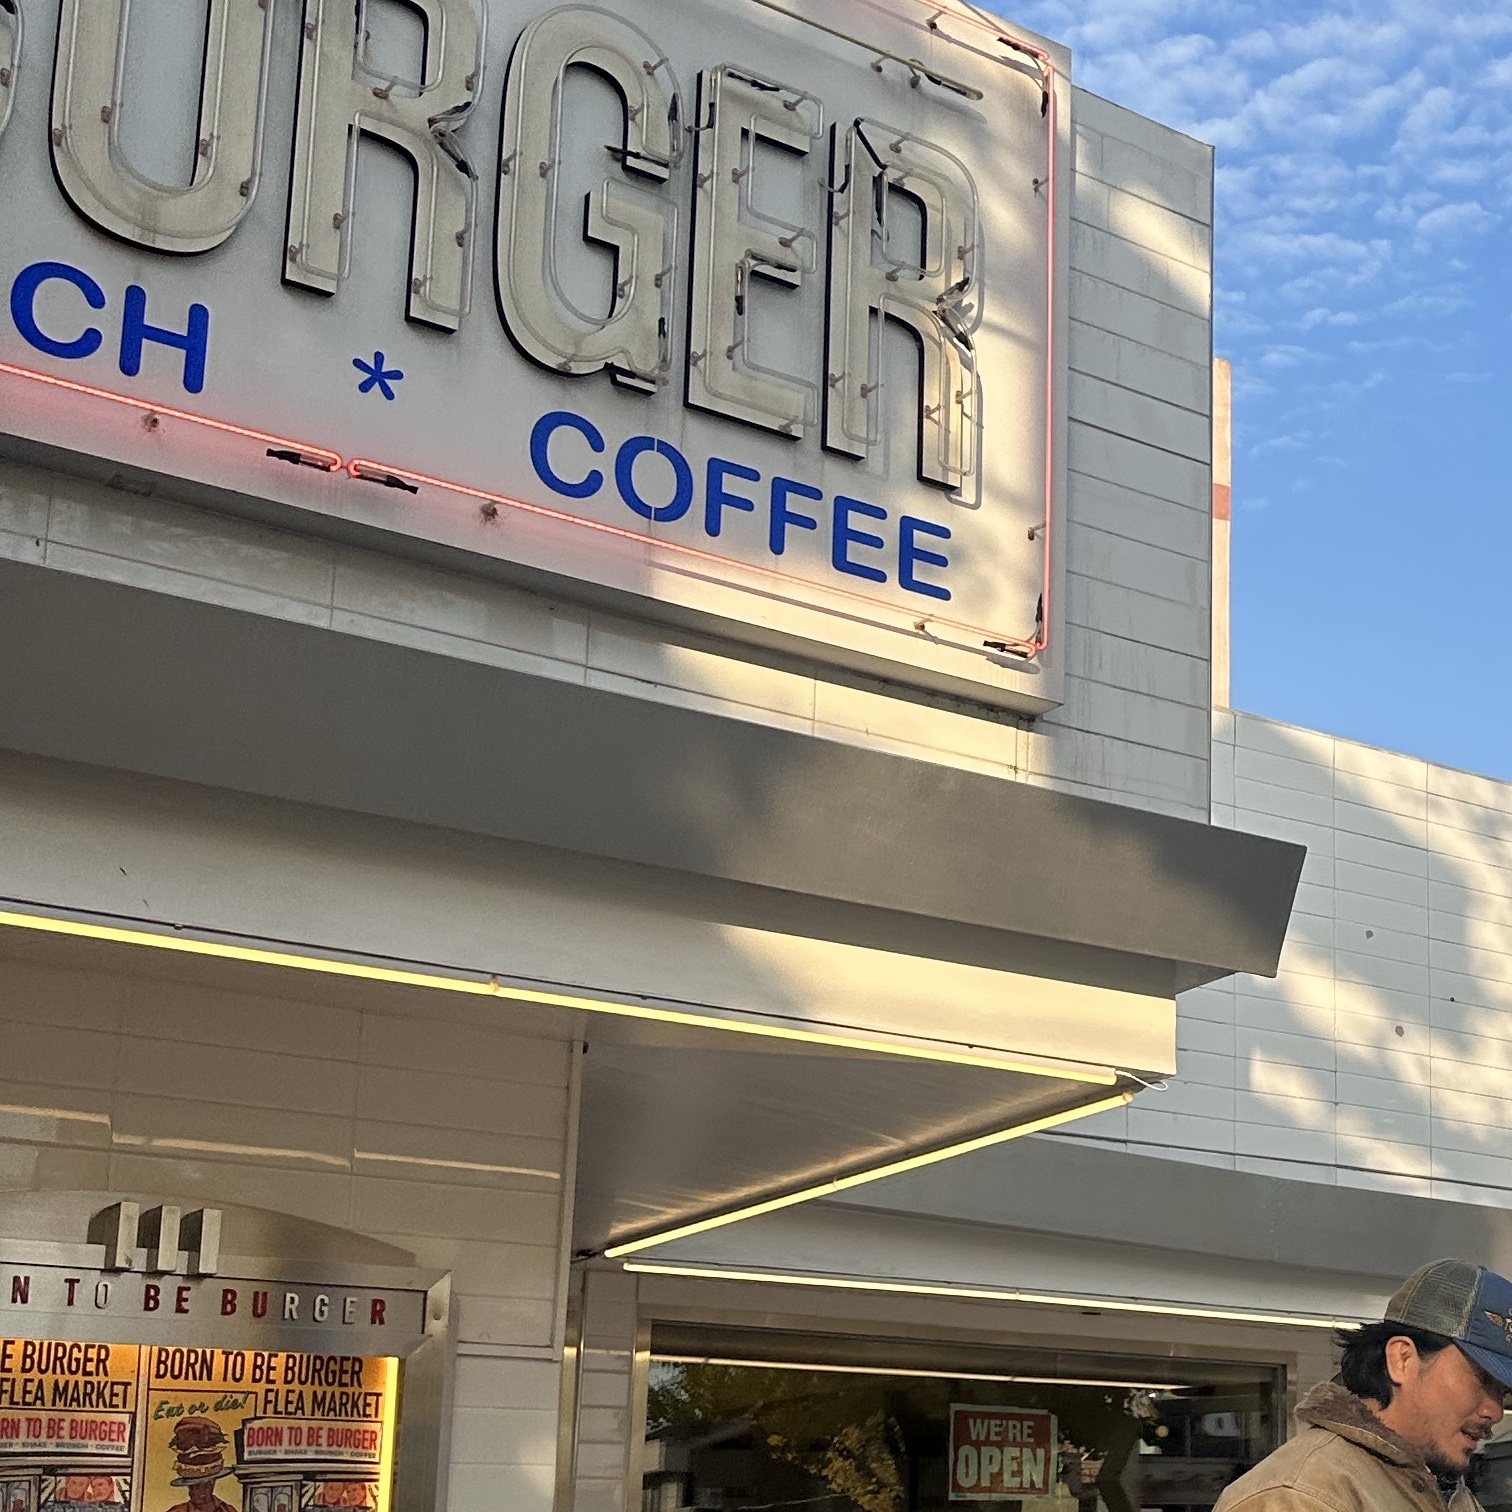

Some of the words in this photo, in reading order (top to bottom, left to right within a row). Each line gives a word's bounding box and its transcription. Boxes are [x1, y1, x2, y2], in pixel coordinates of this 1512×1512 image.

[0, 0, 980, 492] URGER
[10, 261, 209, 394] CH
[529, 410, 953, 600] COFFEE
[64, 1278, 110, 1309] TO
[143, 1283, 191, 1314] BE
[220, 1288, 387, 1325] BURGER
[21, 1340, 110, 1377] BURGER
[155, 1348, 215, 1382] BORN
[221, 1350, 246, 1383] TO
[252, 1352, 279, 1384] BE
[283, 1354, 363, 1388] BURGER
[0, 1377, 45, 1406] FLEA
[51, 1380, 133, 1409] MARKET
[153, 1401, 185, 1420] Eat
[214, 1391, 249, 1412] die!
[262, 1388, 305, 1416] FLEA
[311, 1391, 383, 1418] MARKET
[25, 1418, 42, 1439] TO
[47, 1418, 65, 1439] BE
[69, 1419, 127, 1442] BURGER
[247, 1427, 283, 1448] BORN
[287, 1427, 303, 1448] TO
[307, 1428, 323, 1448] BE
[327, 1429, 378, 1450] BURGER
[968, 1418, 1036, 1443] WE'RE
[956, 1444, 1045, 1489] OPEN
